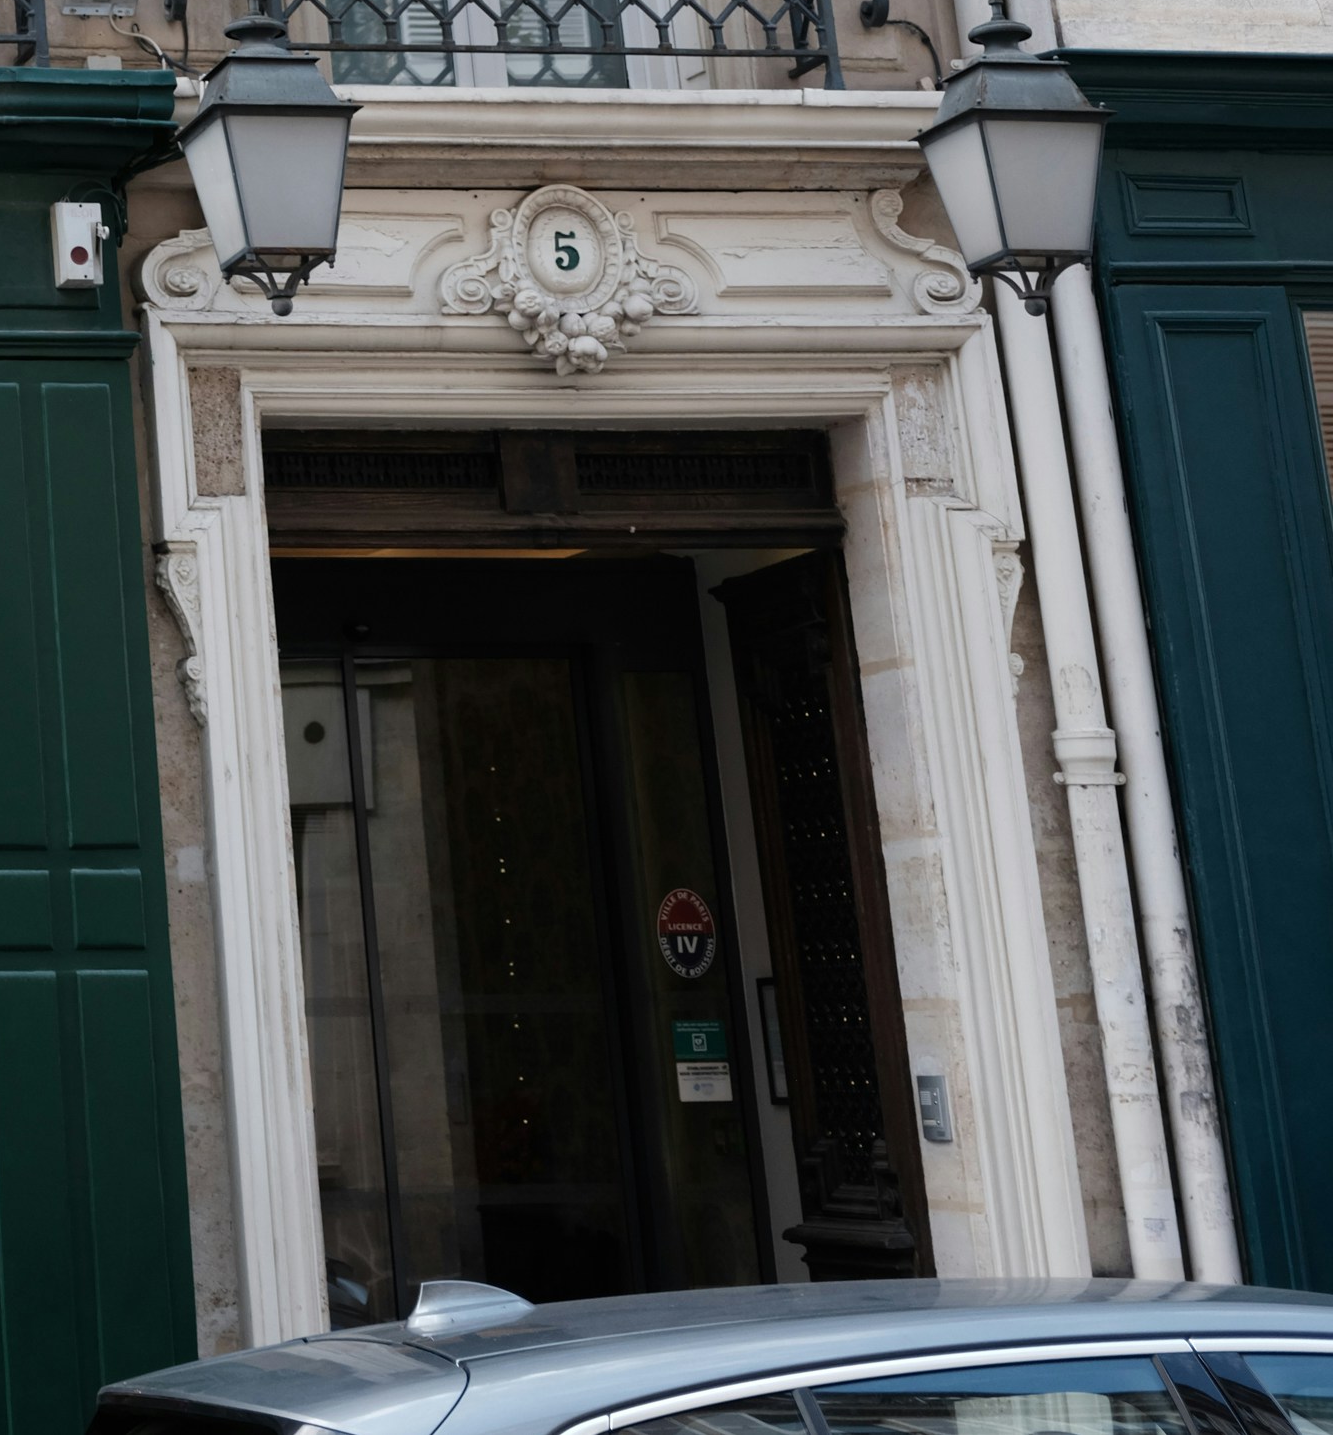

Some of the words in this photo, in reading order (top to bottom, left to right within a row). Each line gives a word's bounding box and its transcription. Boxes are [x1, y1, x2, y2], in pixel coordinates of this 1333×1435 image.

[554, 231, 580, 271] 5
[660, 895, 676, 920] VILLE
[676, 891, 688, 899] DE
[690, 895, 709, 922] PARIS
[668, 923, 703, 931] LICENCE
[675, 964, 687, 975] DE
[689, 938, 714, 976] BOISSONS
[676, 936, 698, 954] IV
